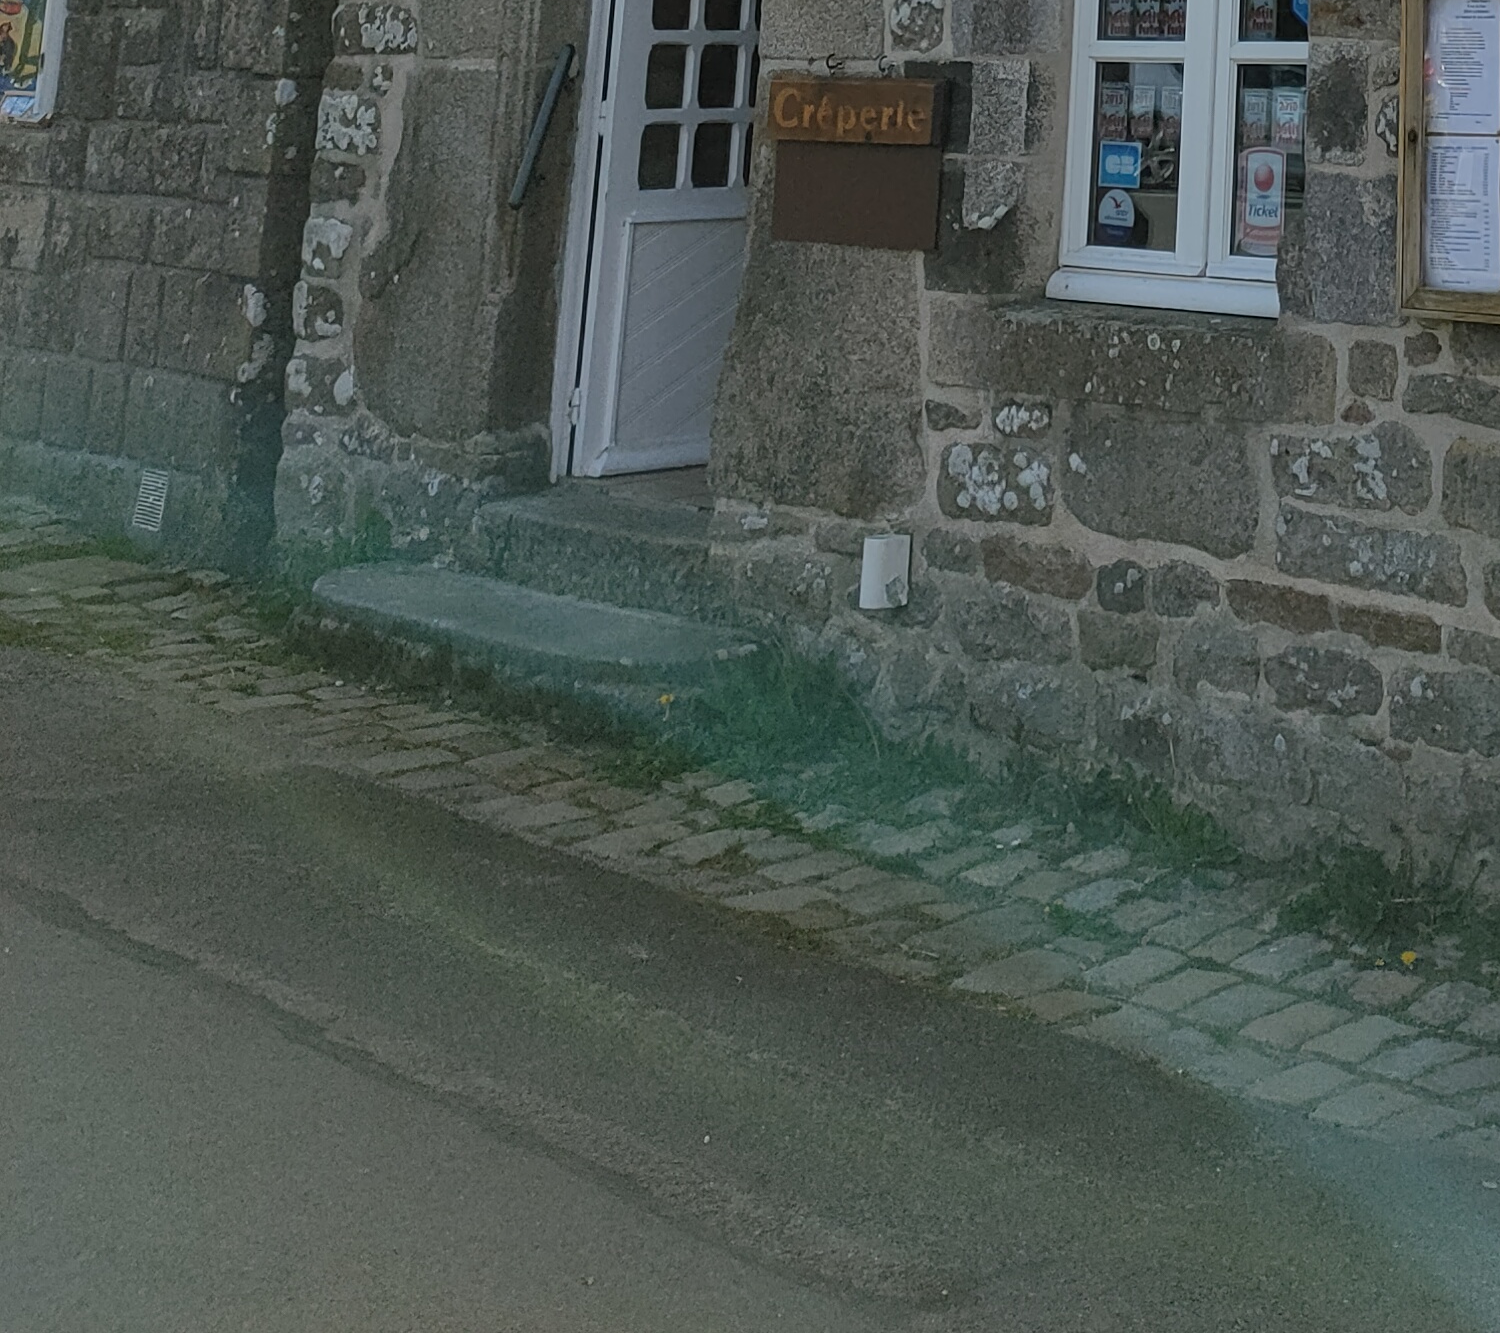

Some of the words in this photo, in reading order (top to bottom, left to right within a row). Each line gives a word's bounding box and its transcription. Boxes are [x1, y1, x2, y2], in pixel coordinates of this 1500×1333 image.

[773, 87, 927, 137] Crêperie
[1105, 154, 1136, 175] CB
[1248, 204, 1279, 219] Ticket
